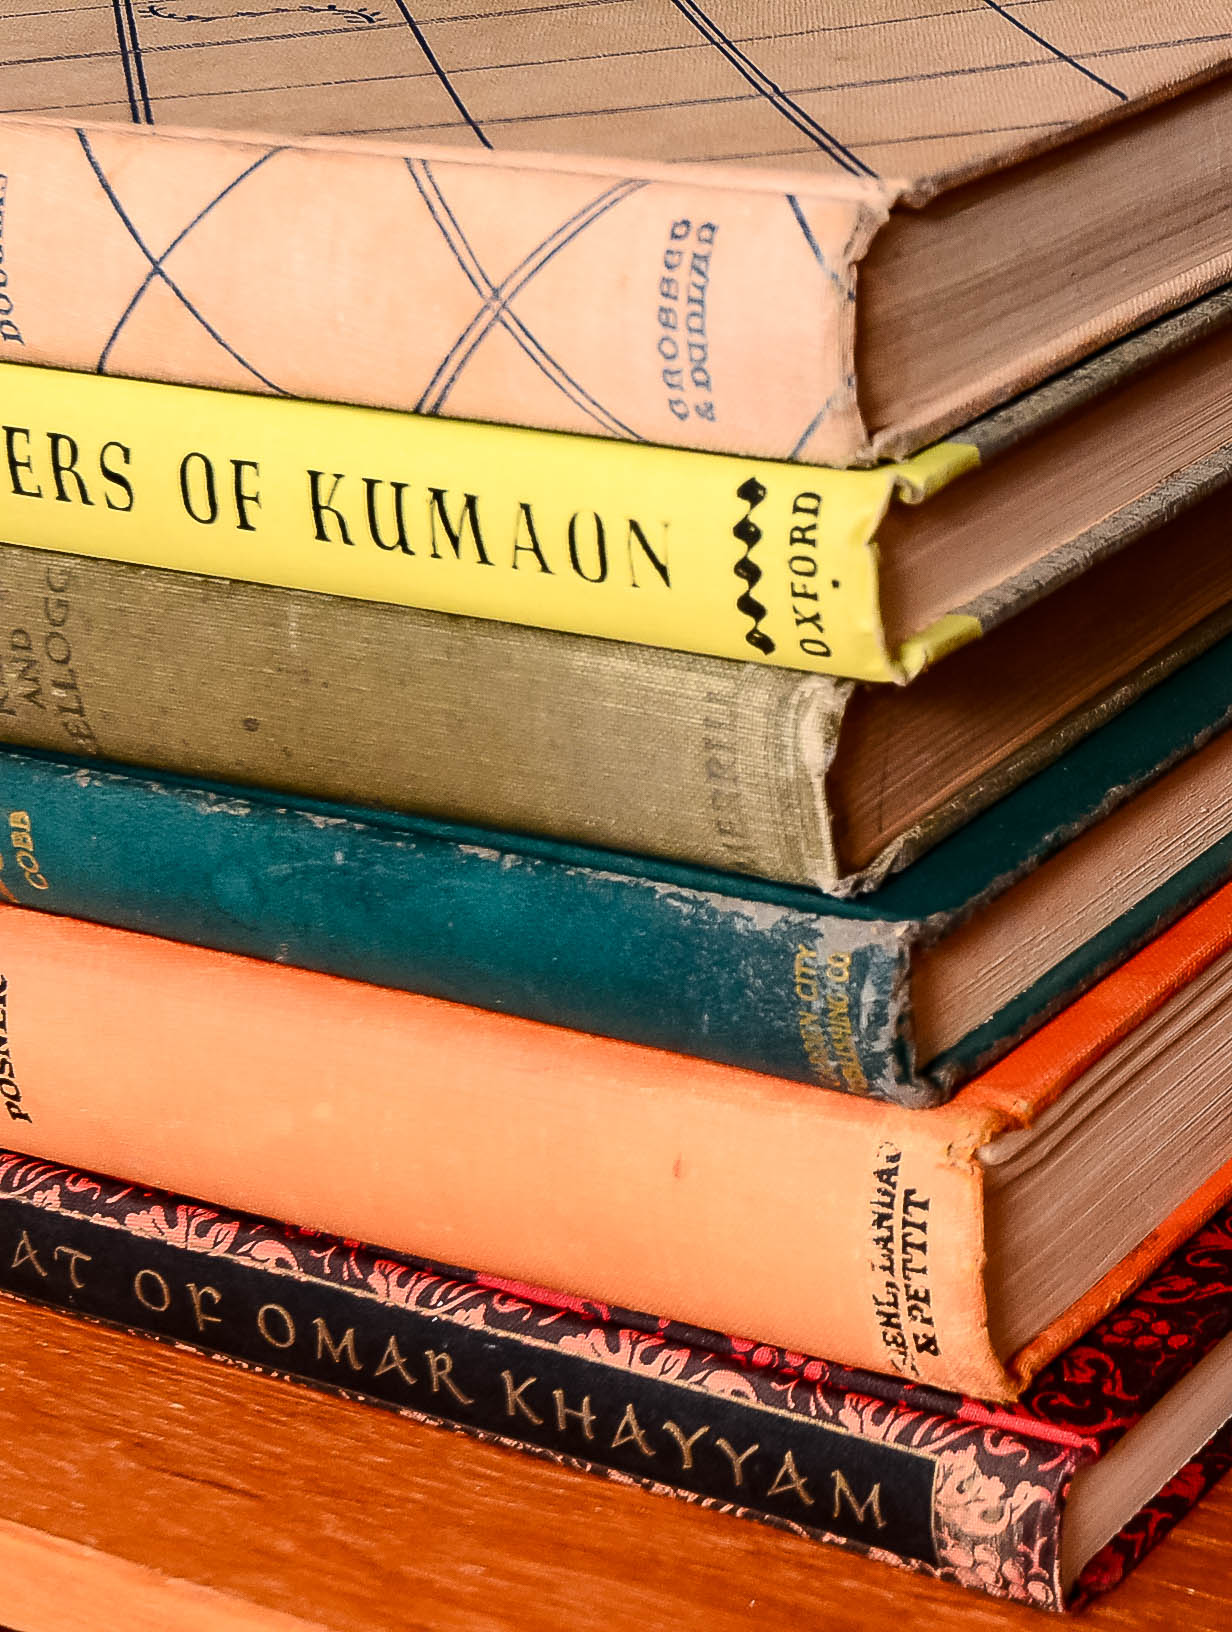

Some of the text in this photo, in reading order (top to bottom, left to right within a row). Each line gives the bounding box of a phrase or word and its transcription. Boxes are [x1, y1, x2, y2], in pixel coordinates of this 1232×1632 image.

[1, 424, 673, 590] ERS OF KUMAON
[788, 490, 833, 658] OXFORD
[11, 627, 47, 710] AND
[8, 810, 48, 890] COBB
[794, 944, 818, 1001] CITY
[827, 952, 850, 983] CO
[0, 974, 32, 1124] POS
[901, 1188, 942, 1356] & PETTIT
[11, 1230, 887, 1529] AT OF OMAR KHAYYAM
